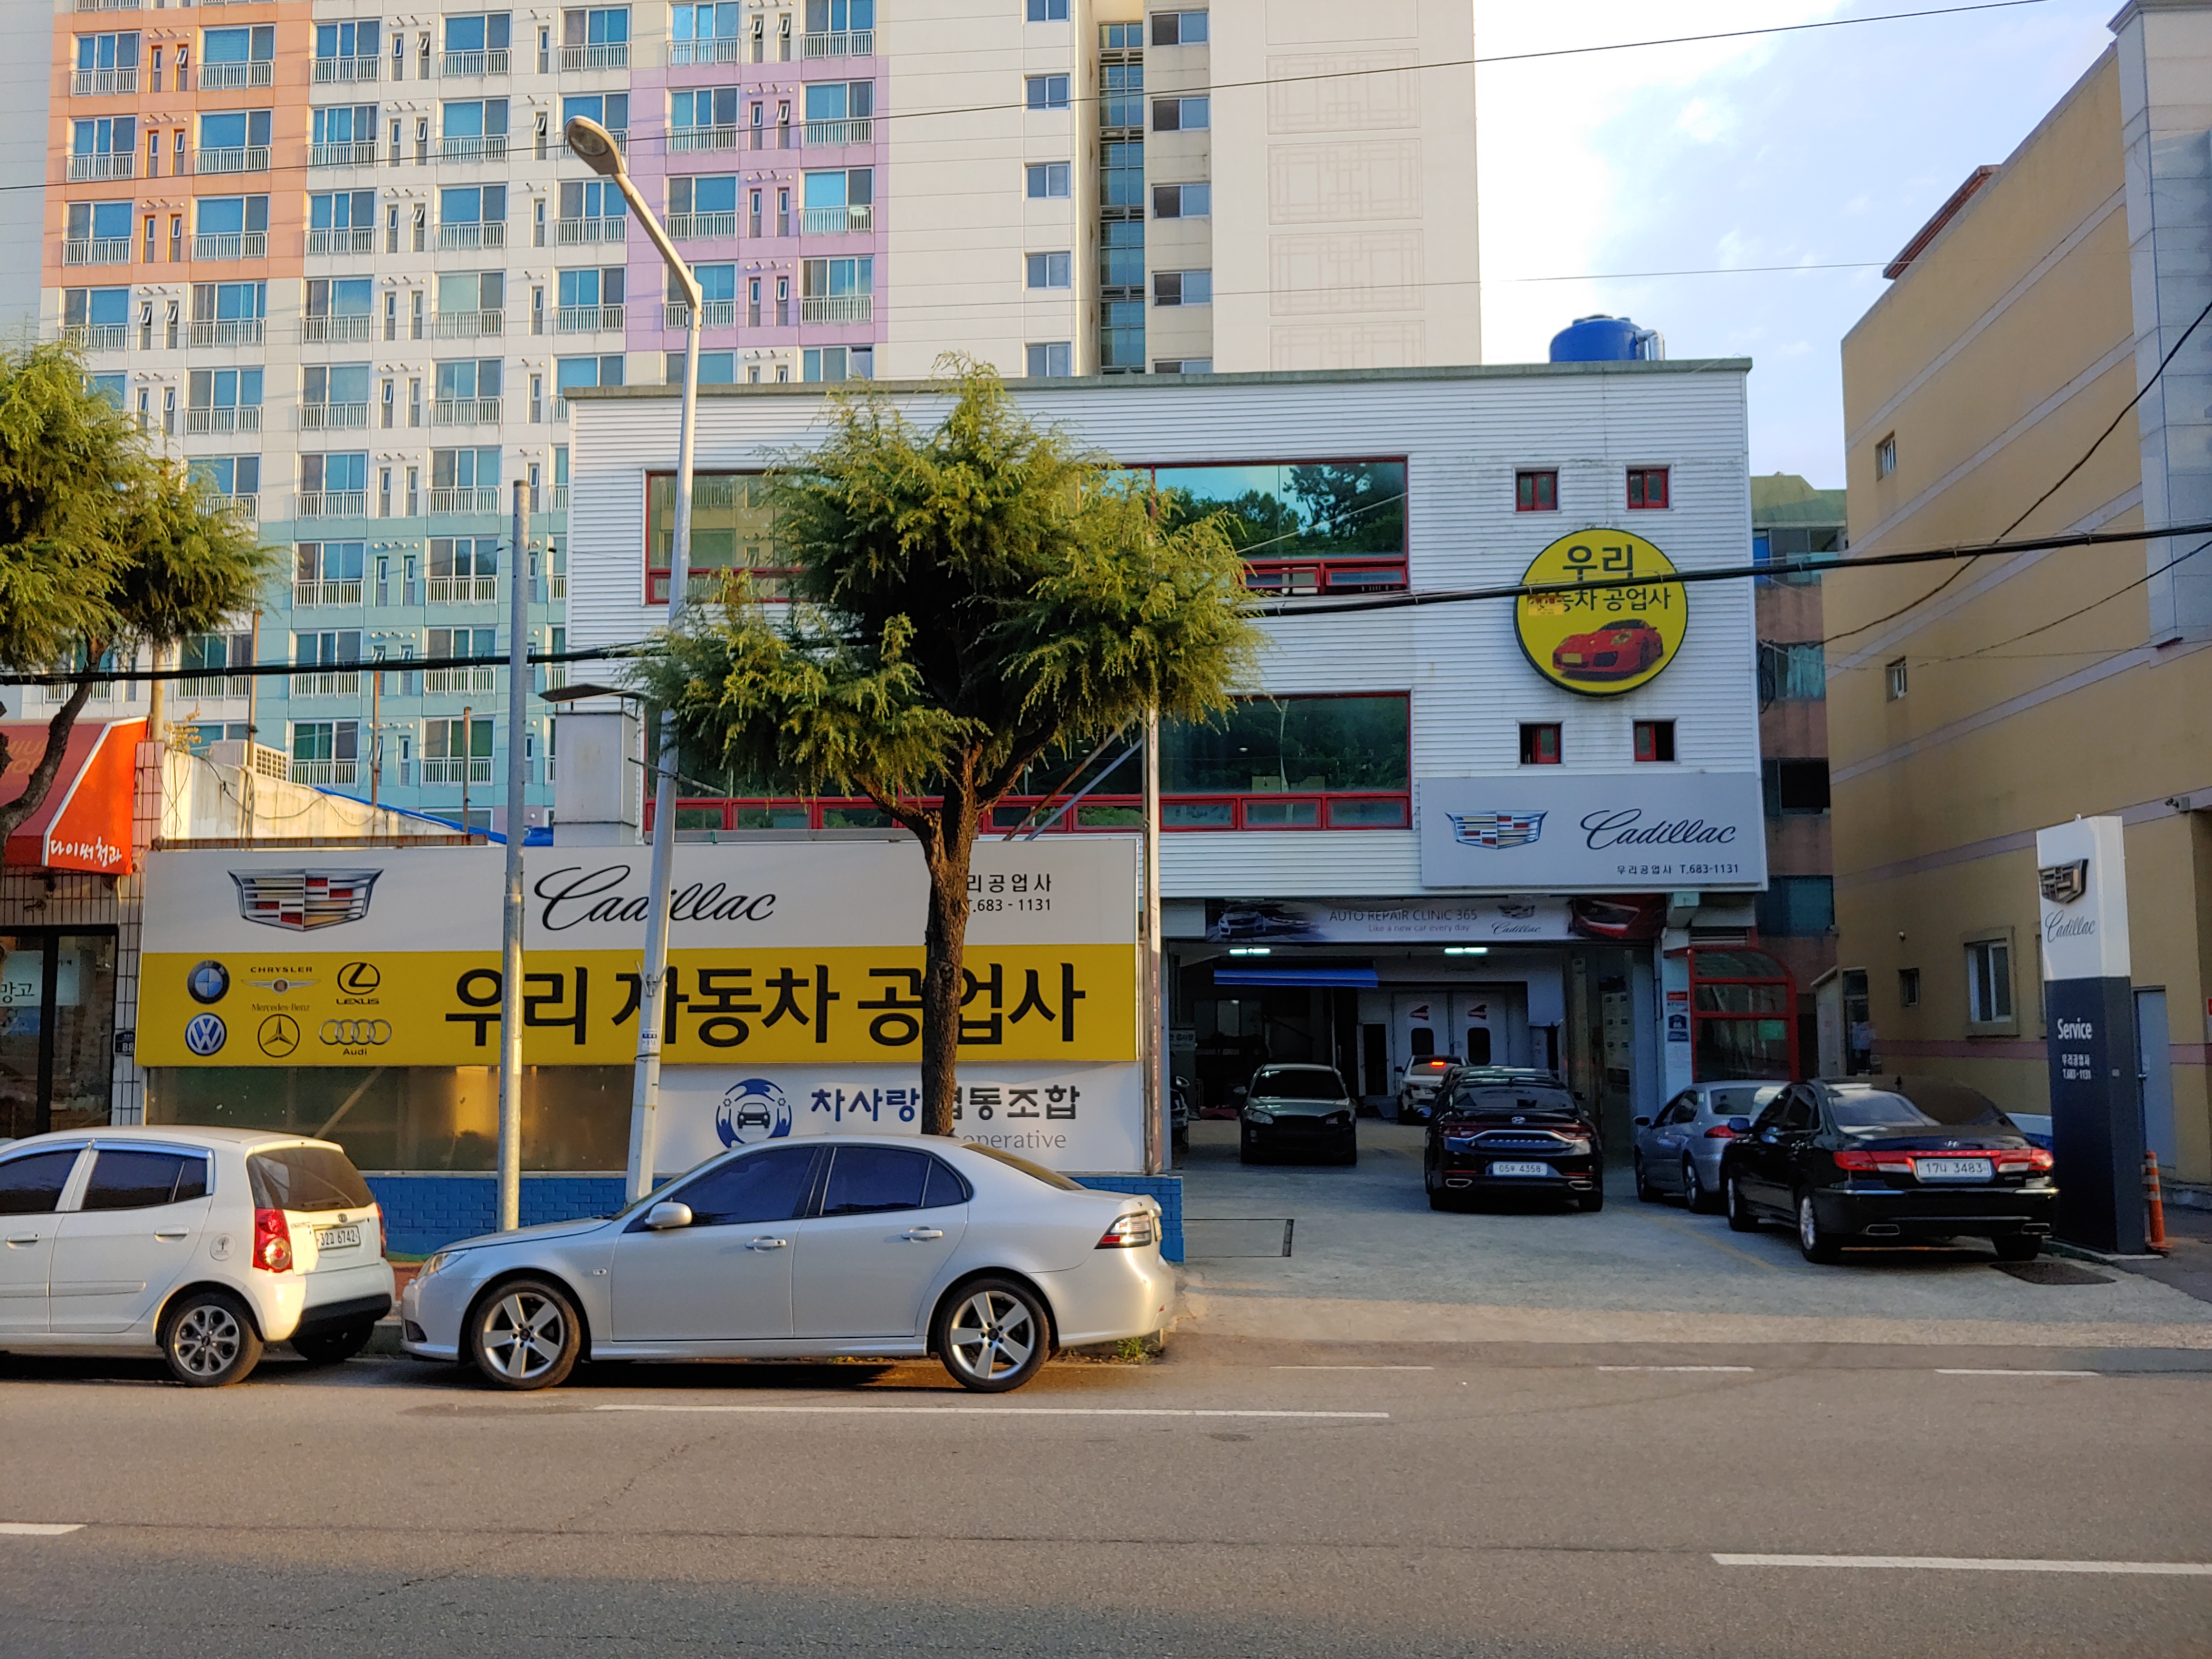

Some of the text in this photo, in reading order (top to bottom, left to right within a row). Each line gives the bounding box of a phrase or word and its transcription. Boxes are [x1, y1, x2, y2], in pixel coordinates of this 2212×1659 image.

[1563, 544, 1633, 582] 우리
[1602, 587, 1671, 611] 공업사
[1581, 809, 1736, 850] Cadillac
[1617, 864, 1739, 875] 우리공업사 T.683-1131
[967, 874, 1051, 893] 리공업사
[534, 865, 776, 930] Cadllac
[1330, 909, 1478, 921] AUTO REPAIR CLINIC 365
[1369, 924, 1384, 932] Like
[1429, 925, 1452, 933] every
[1455, 923, 1470, 933] day
[1491, 921, 1542, 934] Cadillac
[2045, 911, 2096, 943] Cadillac
[251, 1003, 310, 1012] Mercedes-Benz
[445, 963, 1086, 1047] 우리 자동차 공업사
[2057, 1017, 2092, 1040] Service
[343, 1048, 368, 1056] Audi
[1953, 1162, 1983, 1173] 3483
[337, 1230, 355, 1244] 6742
